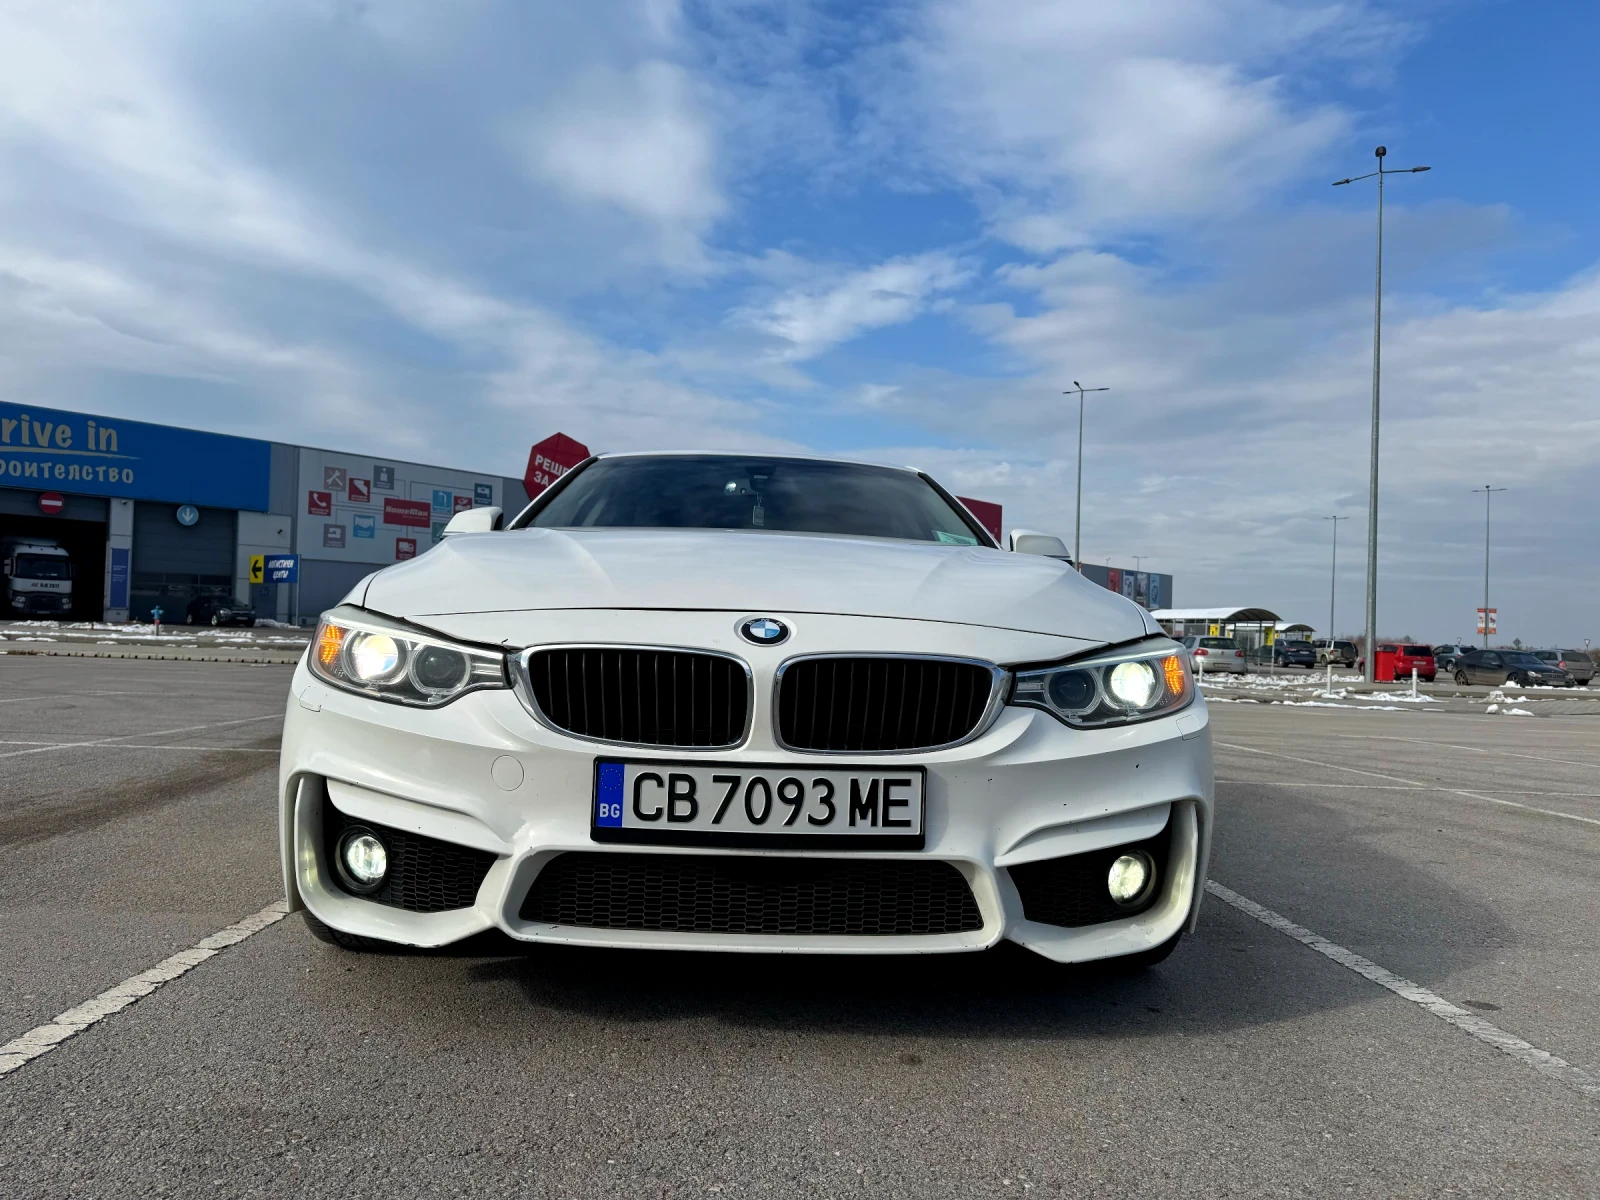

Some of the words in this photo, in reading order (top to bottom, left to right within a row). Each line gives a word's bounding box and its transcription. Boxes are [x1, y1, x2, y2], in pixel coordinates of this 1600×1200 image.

[87, 420, 118, 452] in
[533, 471, 549, 487] ЗА
[599, 803, 620, 819] BG
[632, 772, 698, 823] CB
[711, 774, 836, 826] 7093
[848, 778, 912, 828] ME
